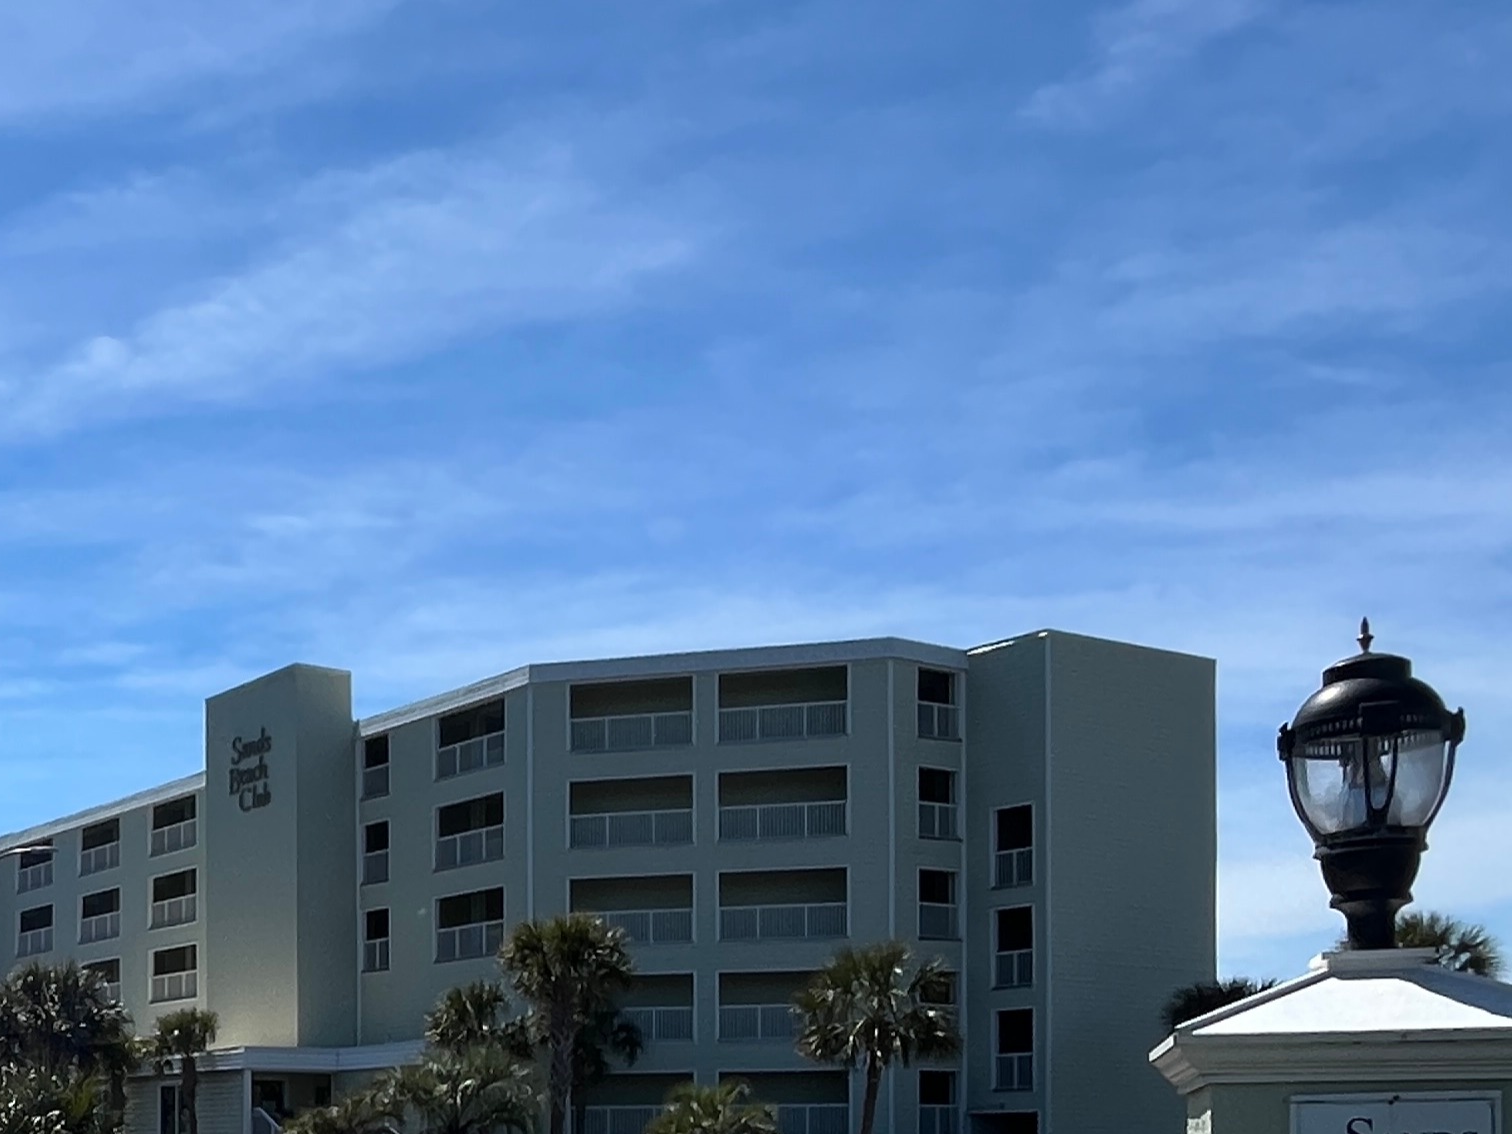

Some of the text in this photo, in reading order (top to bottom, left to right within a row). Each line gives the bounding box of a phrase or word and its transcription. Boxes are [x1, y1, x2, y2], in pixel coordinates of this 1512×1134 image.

[231, 726, 272, 765] Sands
[229, 755, 269, 795] Beach
[238, 782, 272, 813] Club
